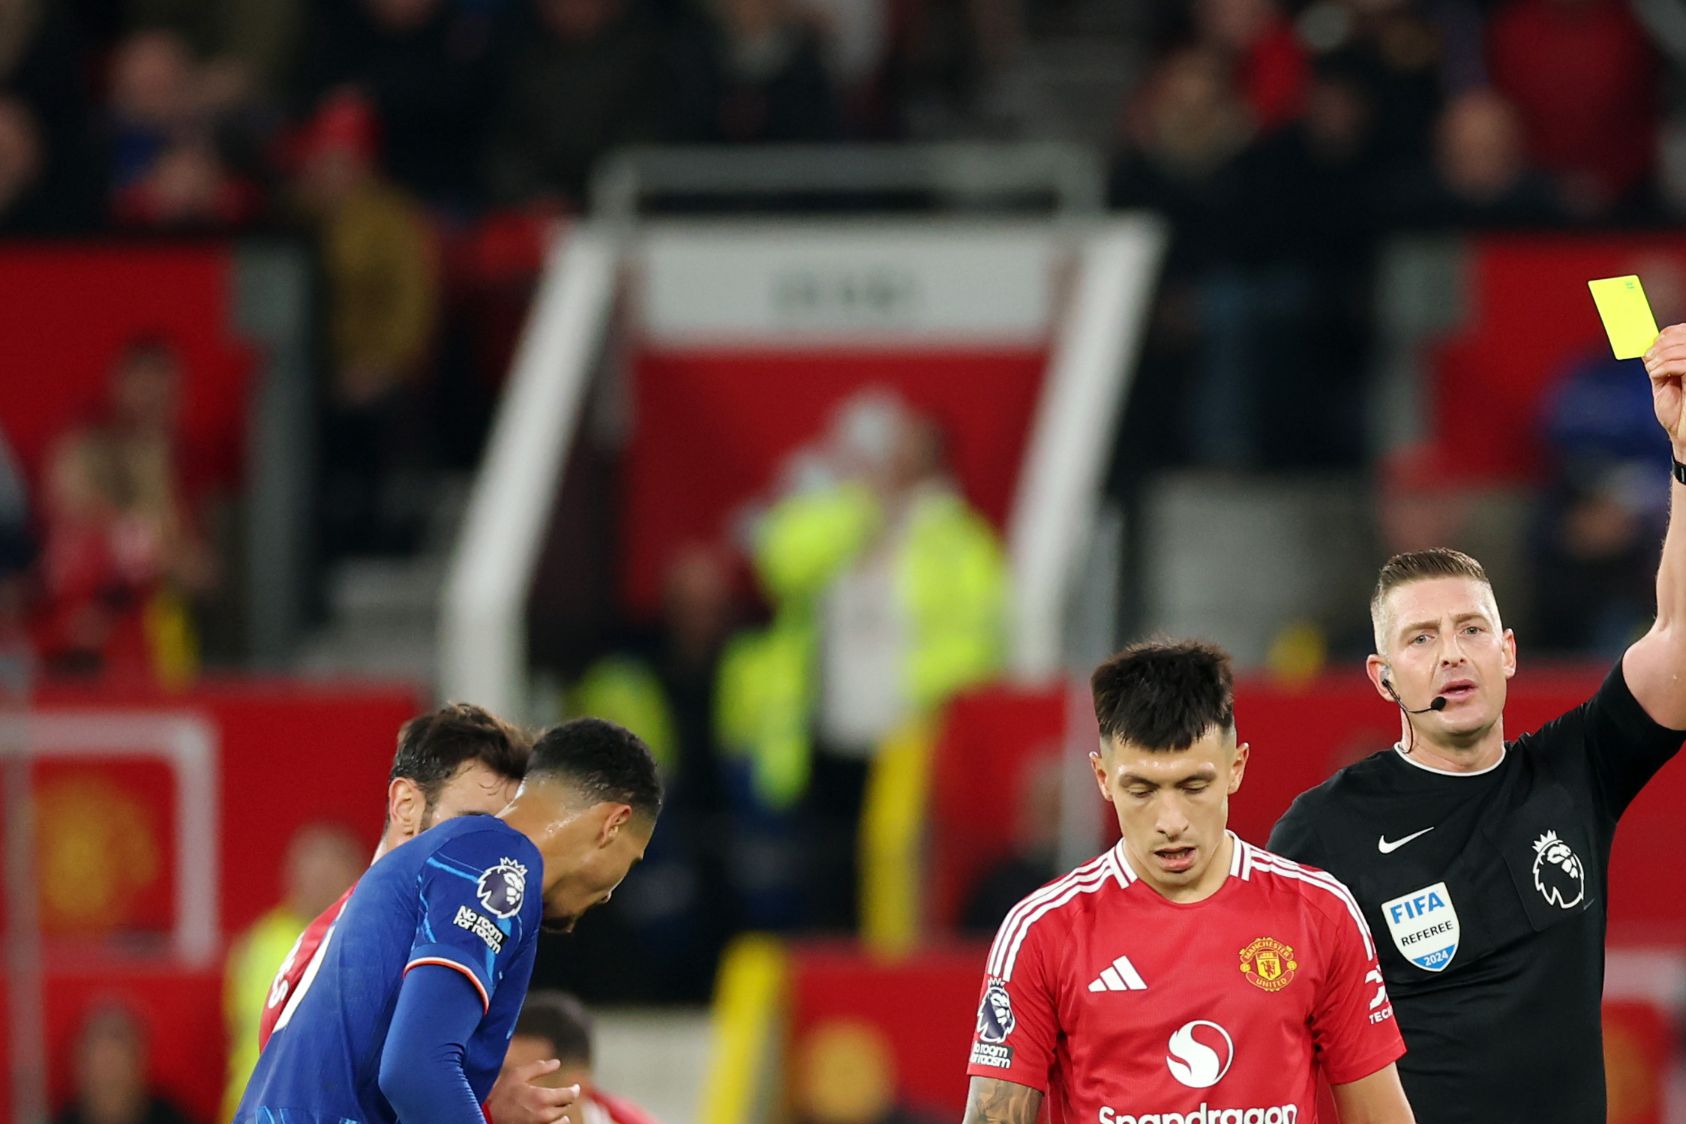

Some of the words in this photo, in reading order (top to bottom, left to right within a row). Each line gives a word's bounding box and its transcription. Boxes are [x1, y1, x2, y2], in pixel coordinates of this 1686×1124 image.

[1390, 892, 1445, 925] FIFA
[1400, 920, 1454, 947] REFEREE
[1423, 949, 1449, 967] 2024
